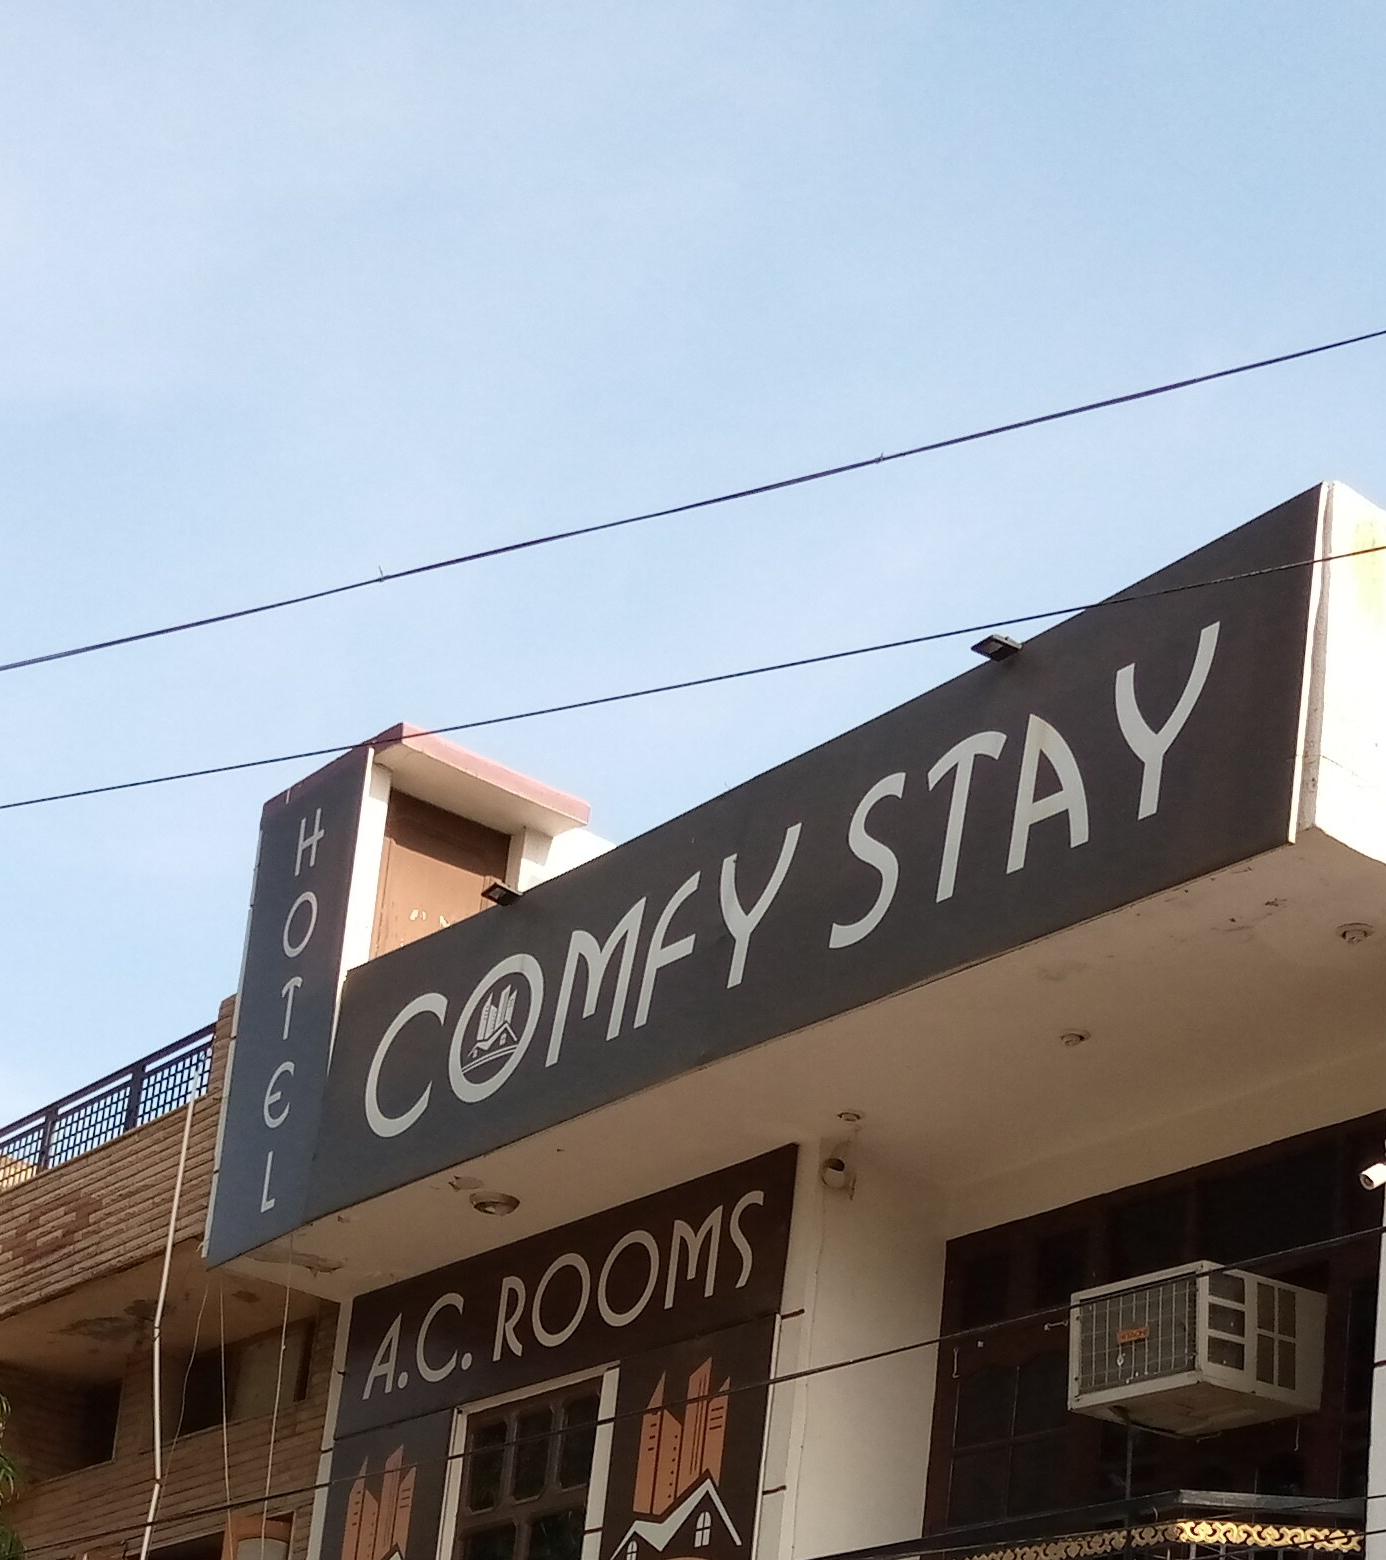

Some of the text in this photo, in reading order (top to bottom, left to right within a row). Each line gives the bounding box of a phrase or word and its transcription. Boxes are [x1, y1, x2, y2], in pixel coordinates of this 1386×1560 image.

[260, 807, 325, 1214] HOTEL
[365, 620, 1221, 1139] COMFY STAY
[362, 1190, 765, 1401] A.C. ROOMS
